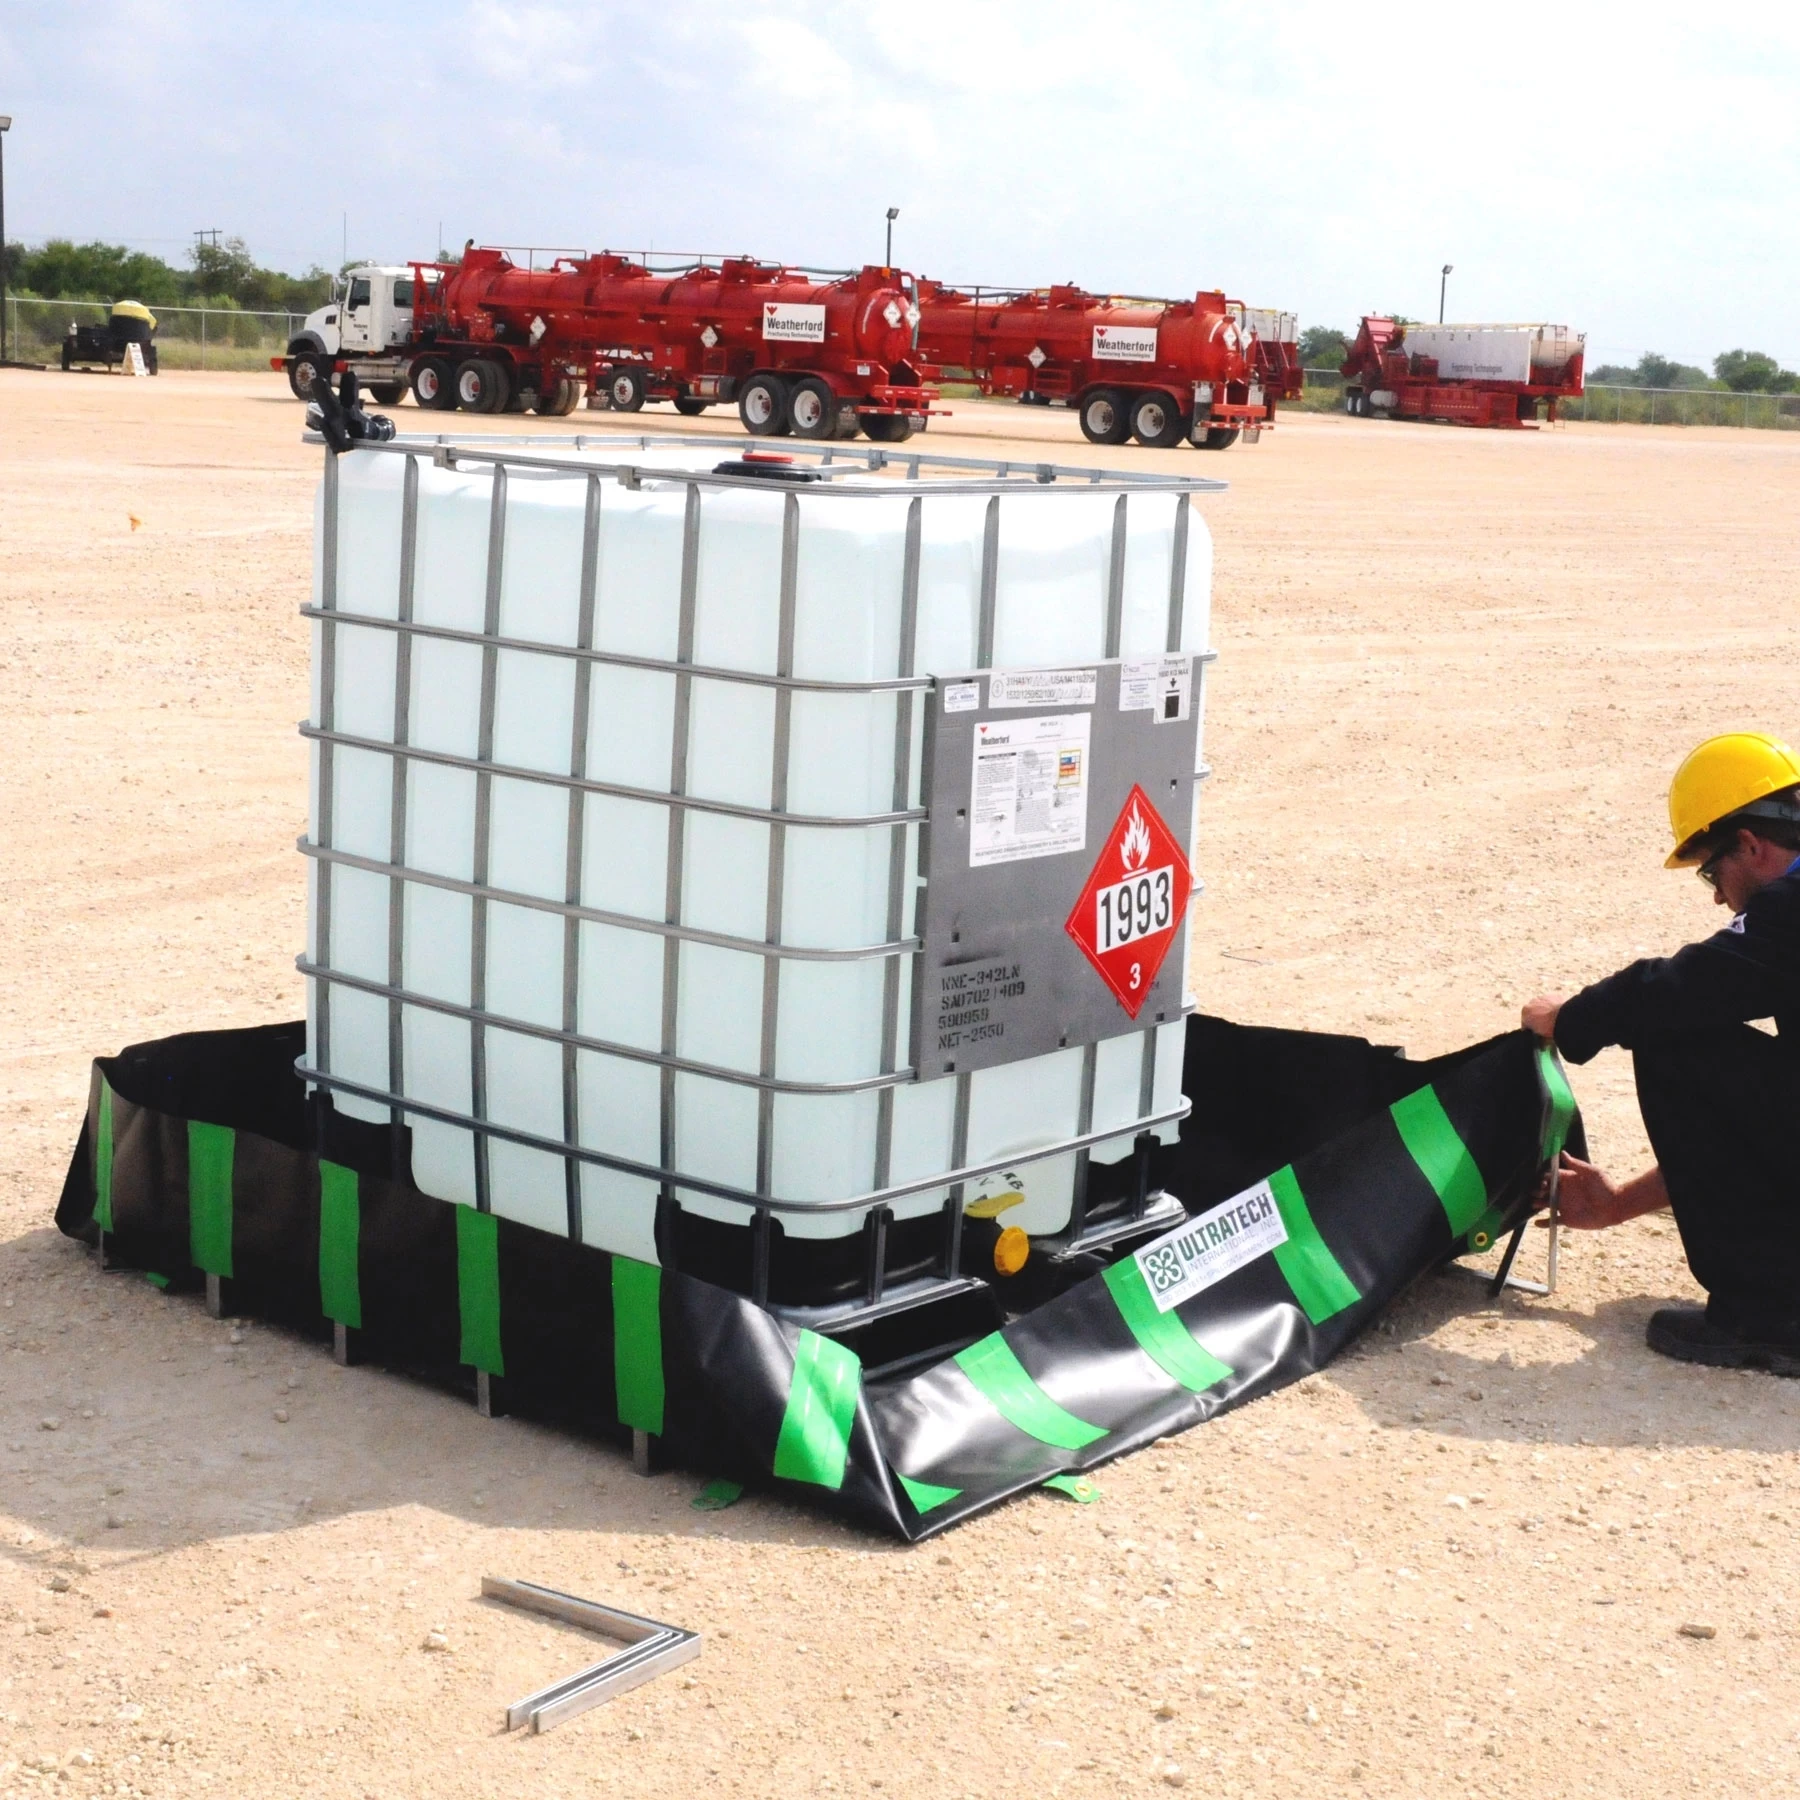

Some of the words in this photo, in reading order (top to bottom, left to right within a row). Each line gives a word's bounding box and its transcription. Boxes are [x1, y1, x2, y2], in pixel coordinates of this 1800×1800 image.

[767, 317, 823, 332] Weatherford
[1097, 338, 1155, 352] Weatherford
[1474, 363, 1503, 376] Technologies
[980, 734, 1010, 746] Weatherford
[1101, 871, 1170, 948] 1993
[1129, 962, 1142, 990] 3
[1177, 1193, 1273, 1262] ULTRATECH
